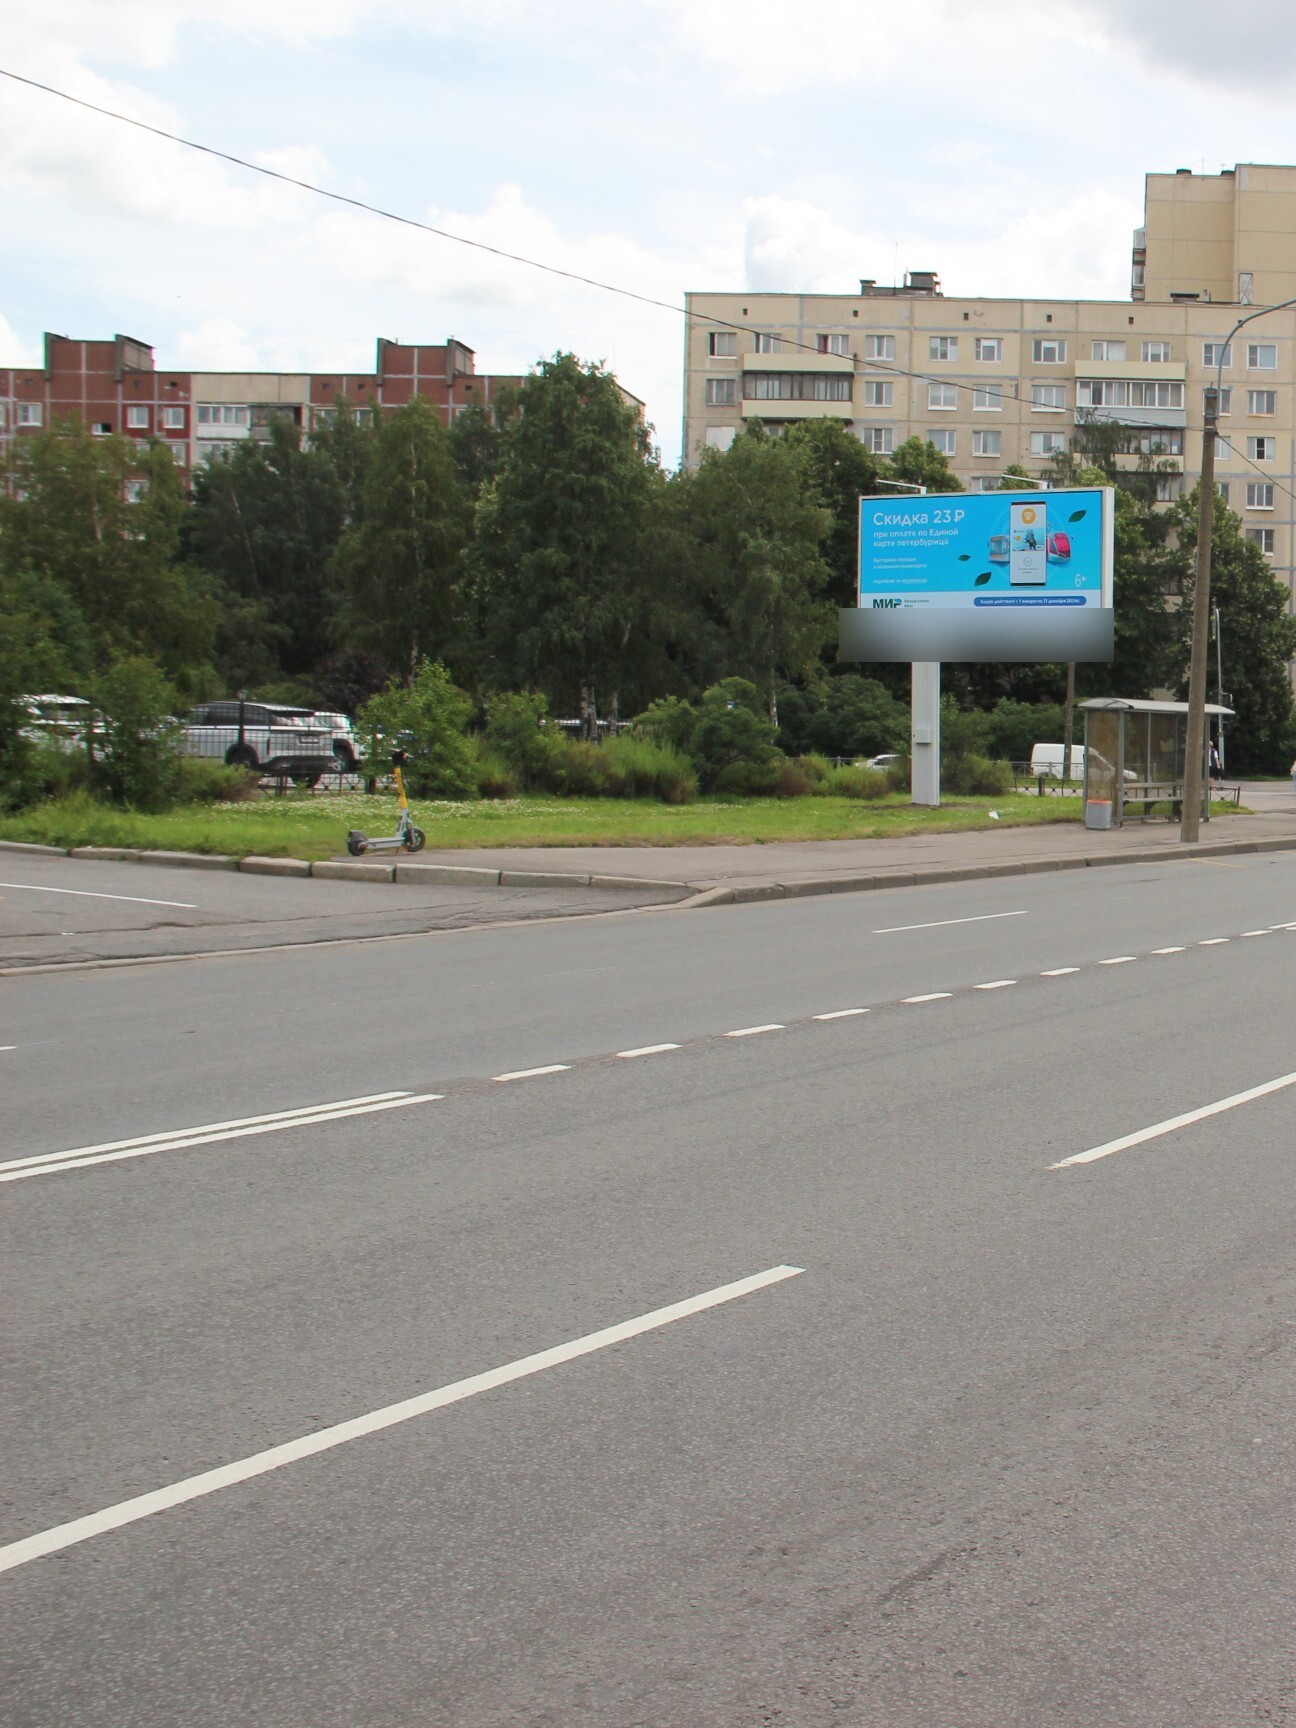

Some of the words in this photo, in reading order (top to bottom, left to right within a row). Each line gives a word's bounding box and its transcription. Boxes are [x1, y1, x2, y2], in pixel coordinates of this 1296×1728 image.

[873, 512, 928, 526] Скидка
[930, 528, 958, 537] Единой
[897, 538, 949, 547] петербуржца
[1074, 574, 1087, 588] 6+
[873, 598, 902, 608] МИР
